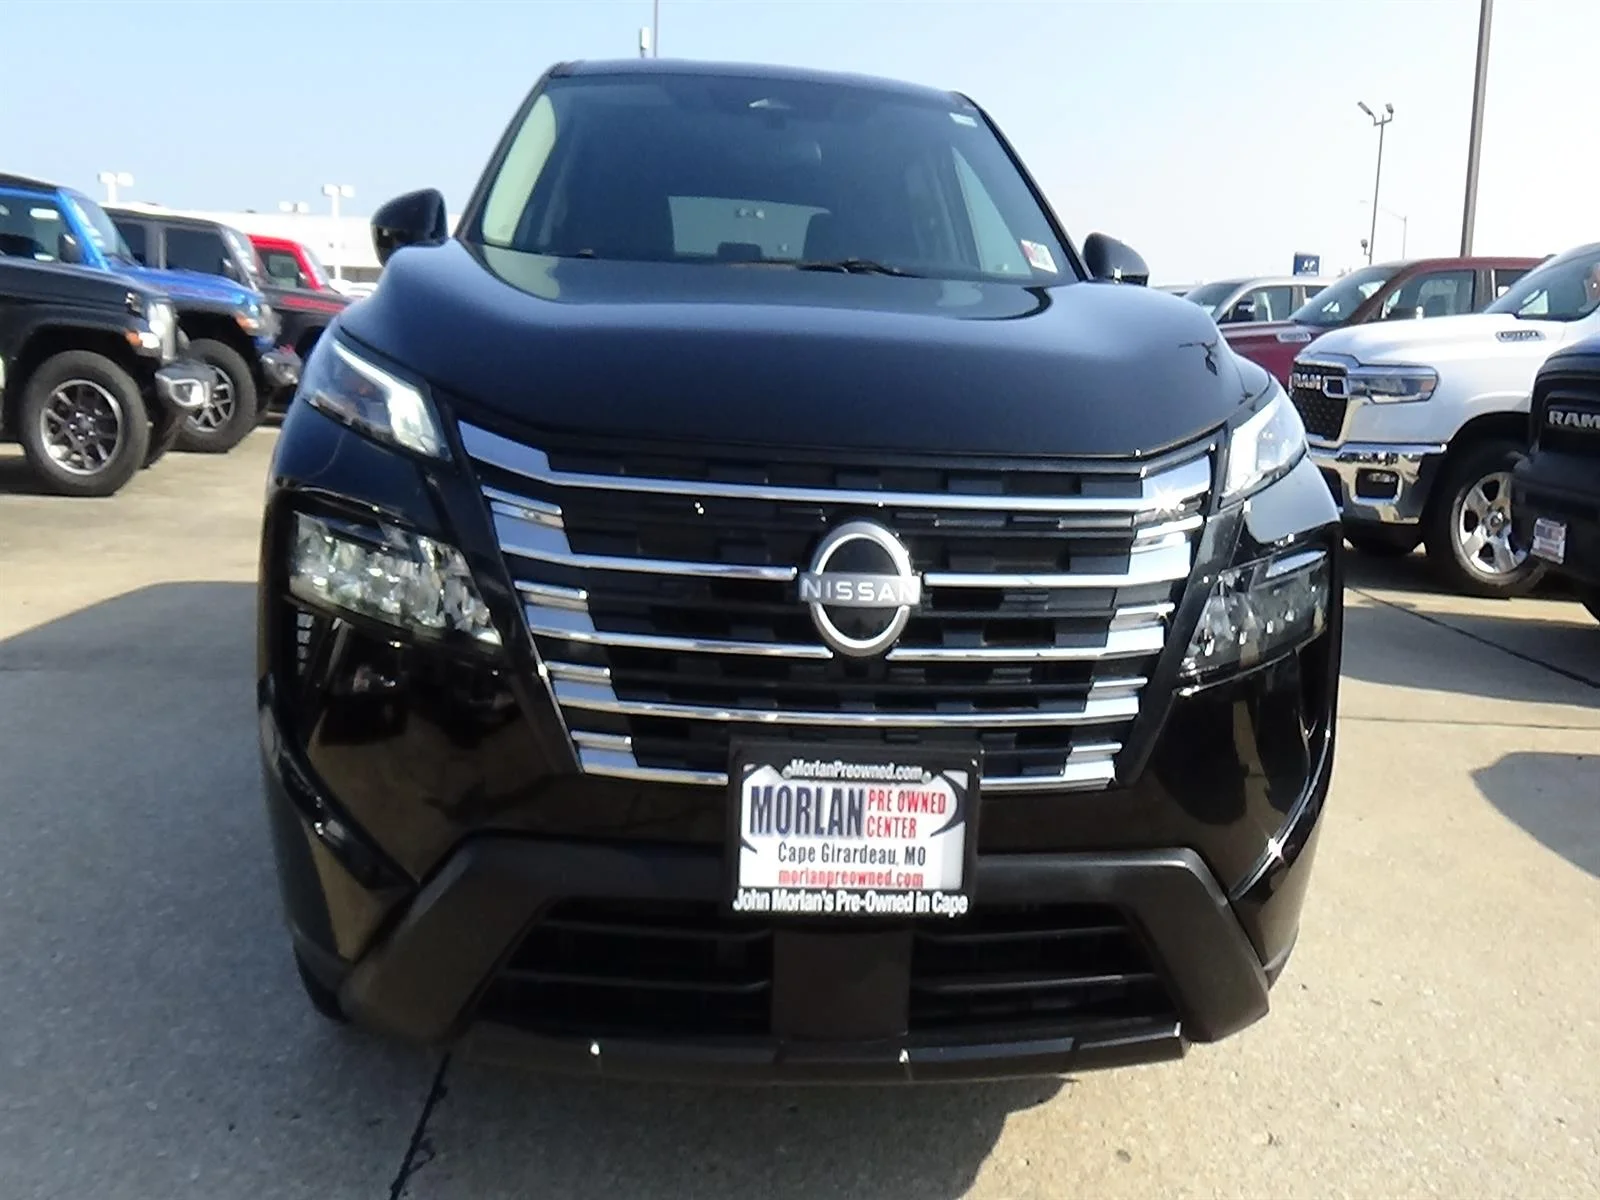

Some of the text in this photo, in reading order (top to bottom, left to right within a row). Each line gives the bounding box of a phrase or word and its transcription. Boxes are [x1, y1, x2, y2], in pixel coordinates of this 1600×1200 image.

[1549, 410, 1600, 429] RAM
[800, 578, 920, 602] NISSAN
[750, 785, 865, 837] MORLAN
[867, 789, 947, 814] PRE OWNED
[866, 816, 917, 839] CENTER
[778, 841, 816, 865] Cape
[904, 846, 926, 866] MO
[778, 868, 924, 888] morlanpreowned.com
[733, 888, 770, 912] John
[771, 889, 834, 913] Morlan's
[836, 889, 913, 913] Pre-Owned
[931, 891, 968, 917] Cape
